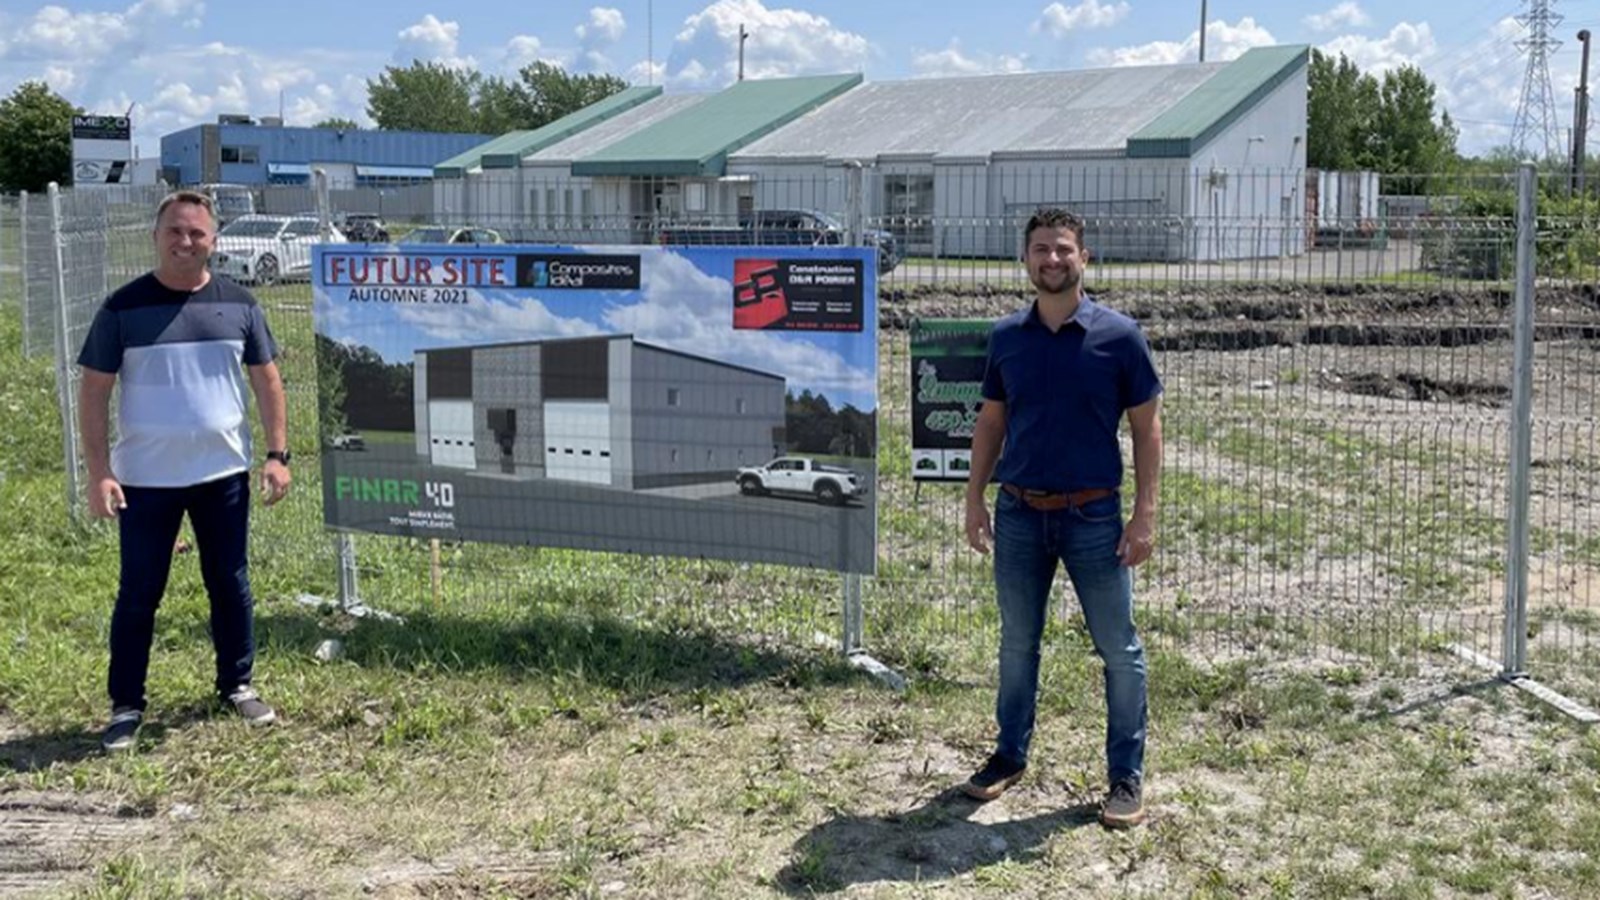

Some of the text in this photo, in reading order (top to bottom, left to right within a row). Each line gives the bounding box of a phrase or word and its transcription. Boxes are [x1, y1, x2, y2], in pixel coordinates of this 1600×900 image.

[331, 256, 505, 286] FUTUR SITE
[549, 260, 634, 278] Composites
[788, 265, 856, 274] Construction
[349, 288, 469, 304] AUTOMNE 2021
[335, 476, 454, 507] FINAR 40
